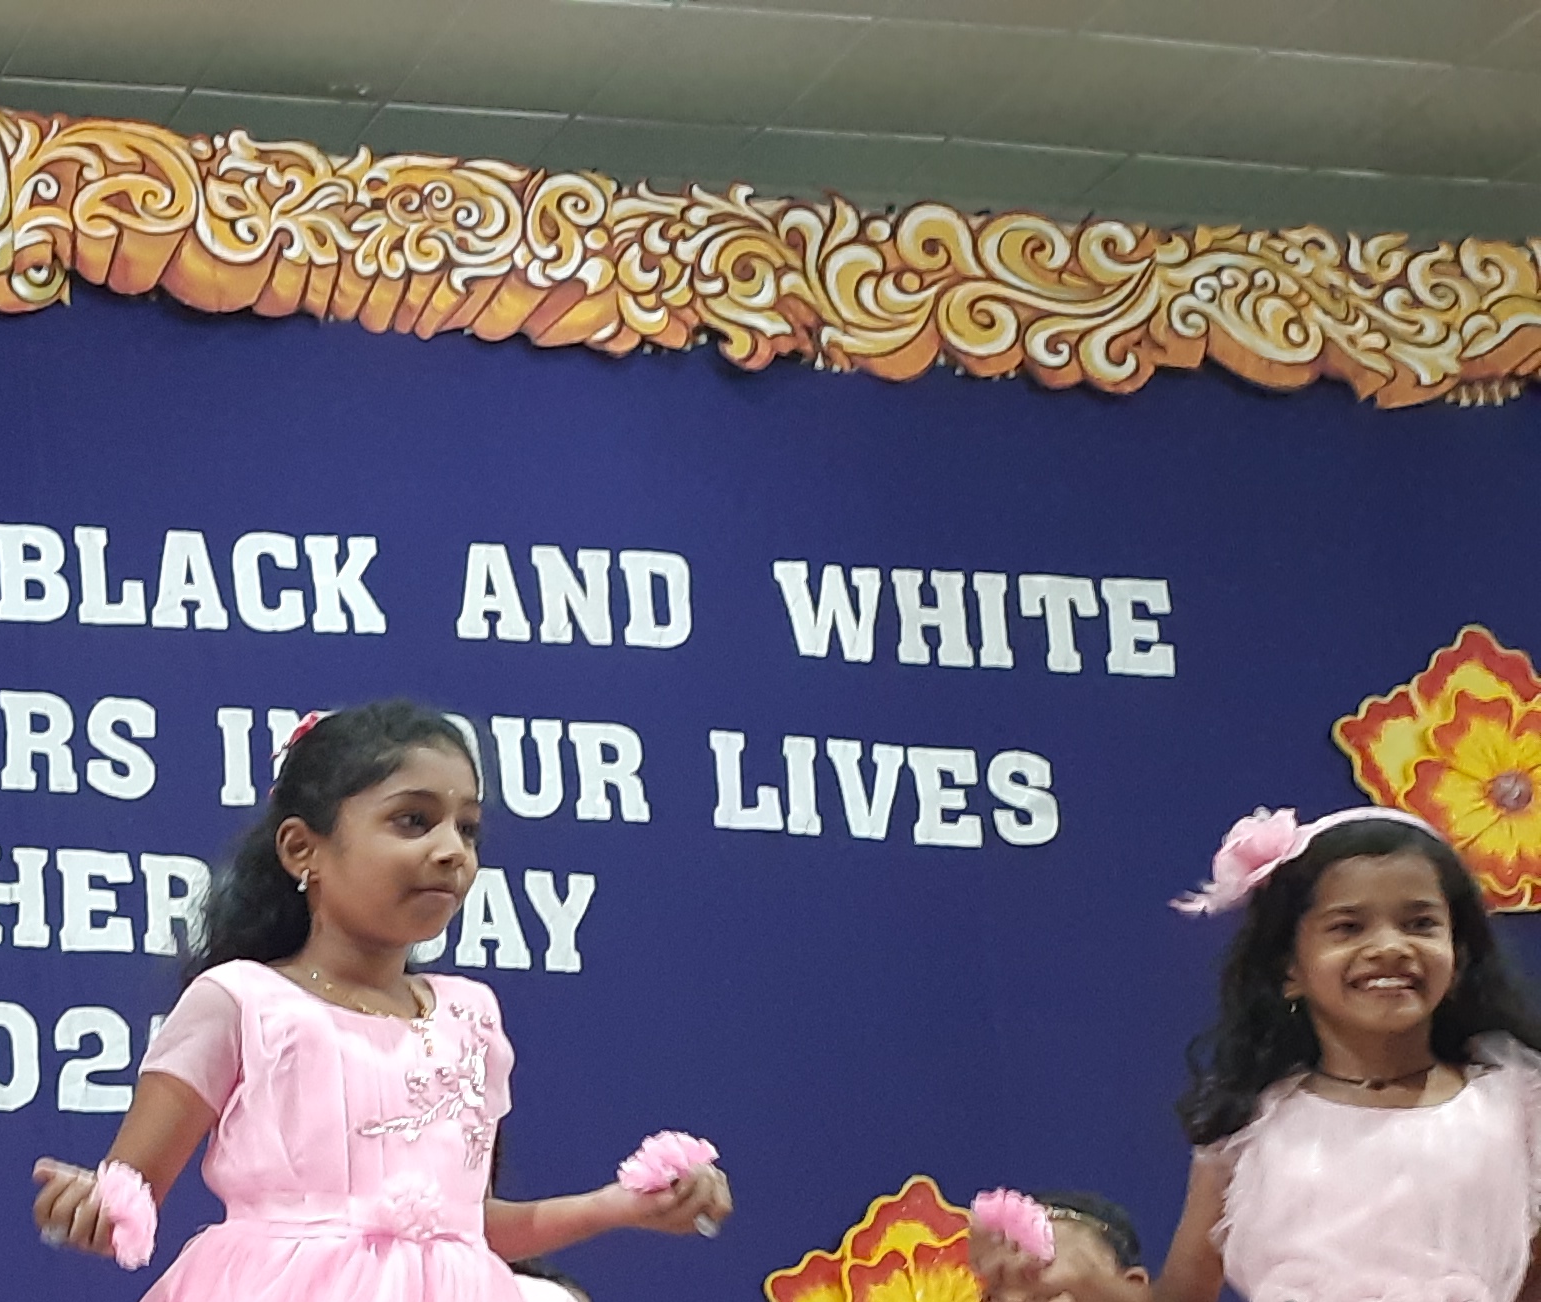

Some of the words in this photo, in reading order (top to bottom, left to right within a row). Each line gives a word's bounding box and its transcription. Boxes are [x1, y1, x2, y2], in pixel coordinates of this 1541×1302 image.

[455, 541, 693, 650] AND
[772, 559, 1177, 679] WHITE
[707, 728, 1060, 850] LIVES
[407, 865, 597, 975] AY
